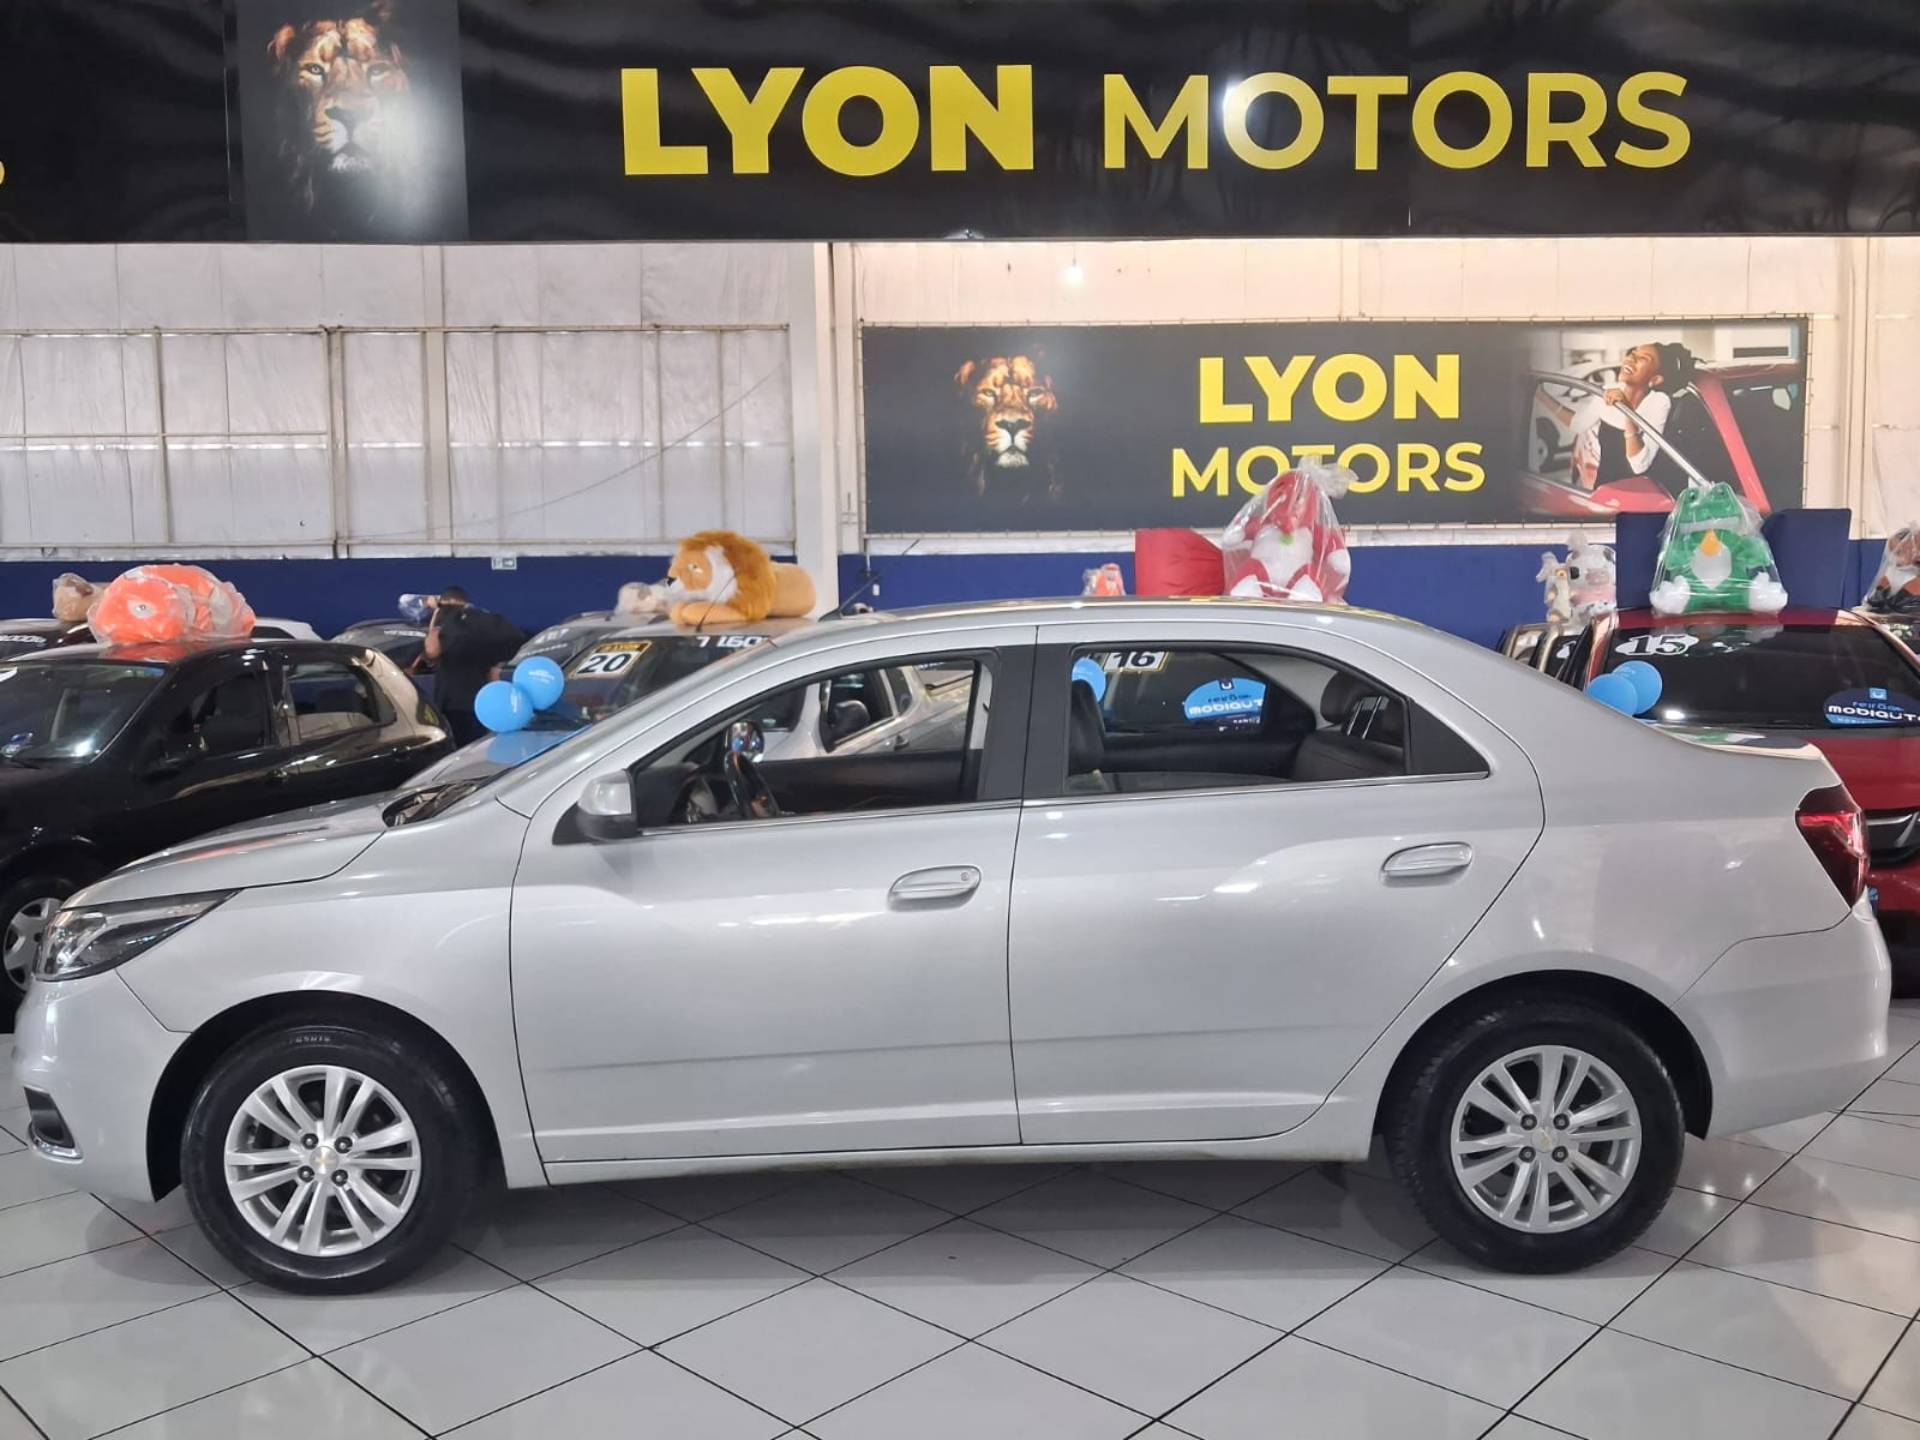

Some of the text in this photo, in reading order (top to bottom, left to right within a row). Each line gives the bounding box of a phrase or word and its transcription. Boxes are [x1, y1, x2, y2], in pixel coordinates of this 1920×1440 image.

[620, 65, 1691, 176] LYON MOTORS
[1198, 352, 1460, 424] LYON
[1631, 634, 1690, 656] 15
[576, 652, 634, 674] 20
[1112, 650, 1156, 668] 16
